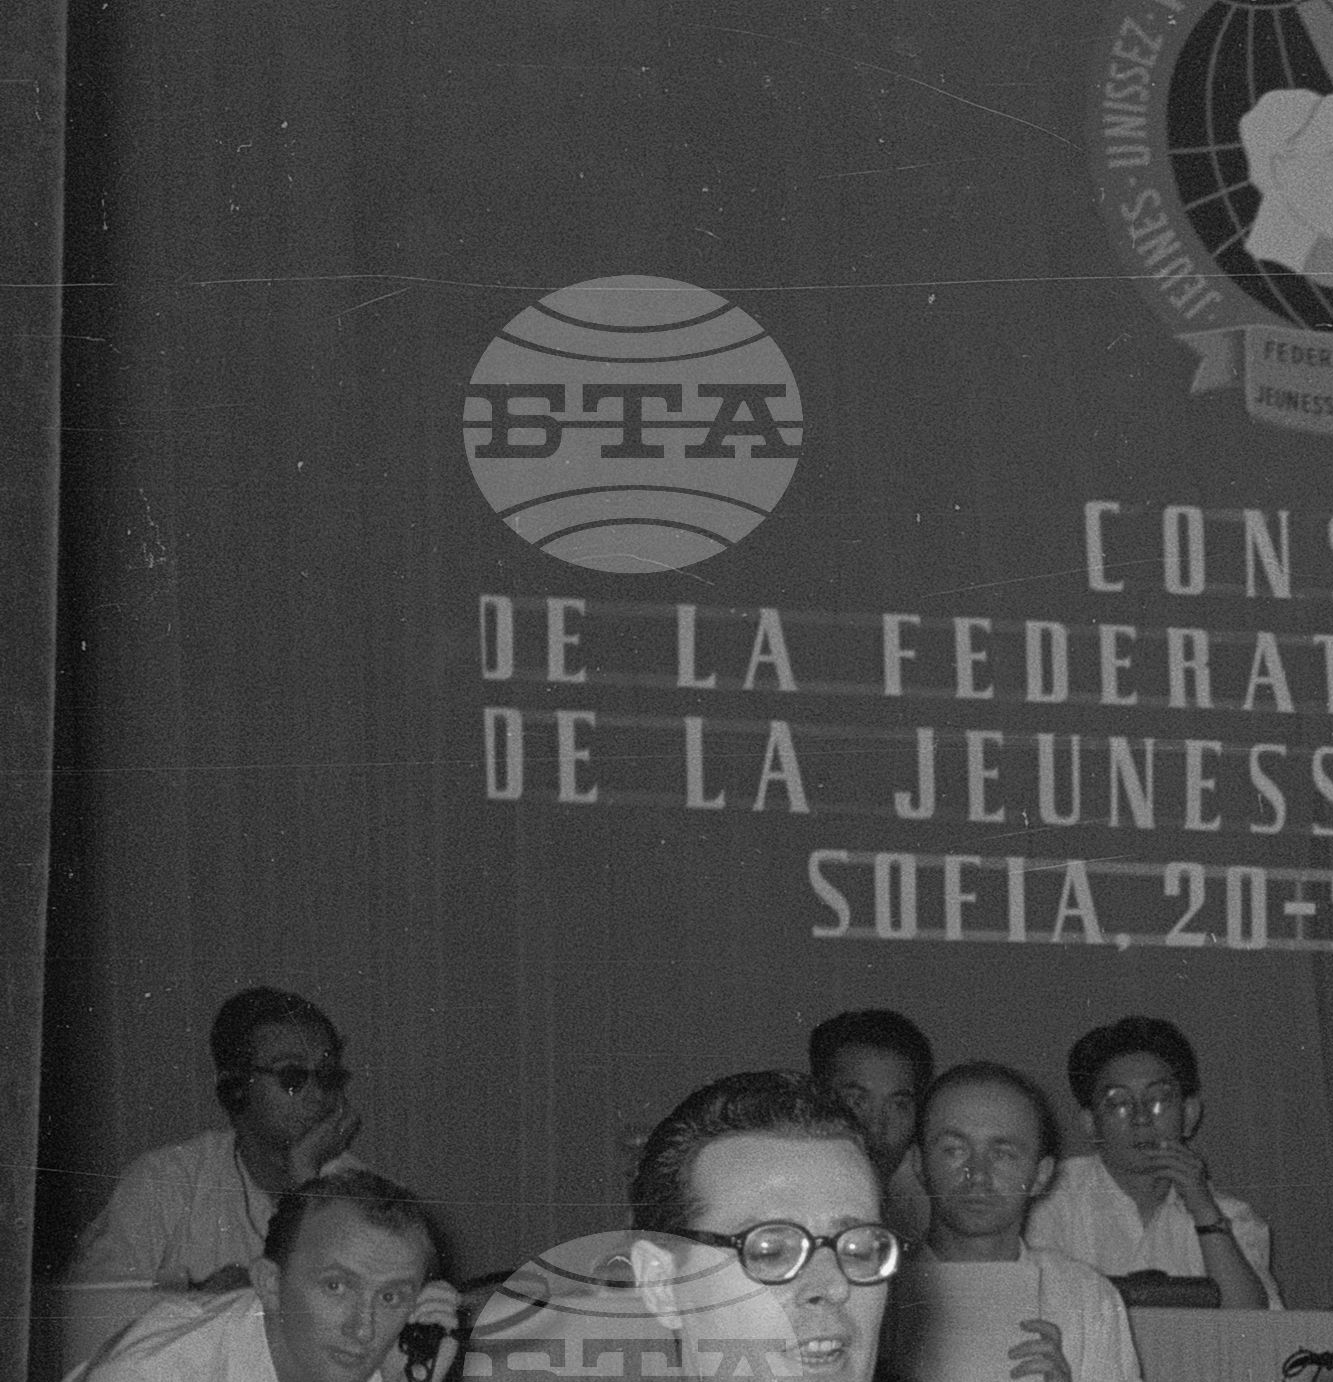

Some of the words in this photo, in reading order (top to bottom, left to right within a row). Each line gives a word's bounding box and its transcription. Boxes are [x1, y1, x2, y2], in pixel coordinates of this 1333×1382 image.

[1102, 16, 1163, 169] UNISSEZ
[1120, 188, 1224, 320] JEUNES
[480, 596, 587, 684] DE
[676, 603, 798, 692] LA
[484, 706, 597, 803] DE
[685, 716, 810, 814] LA
